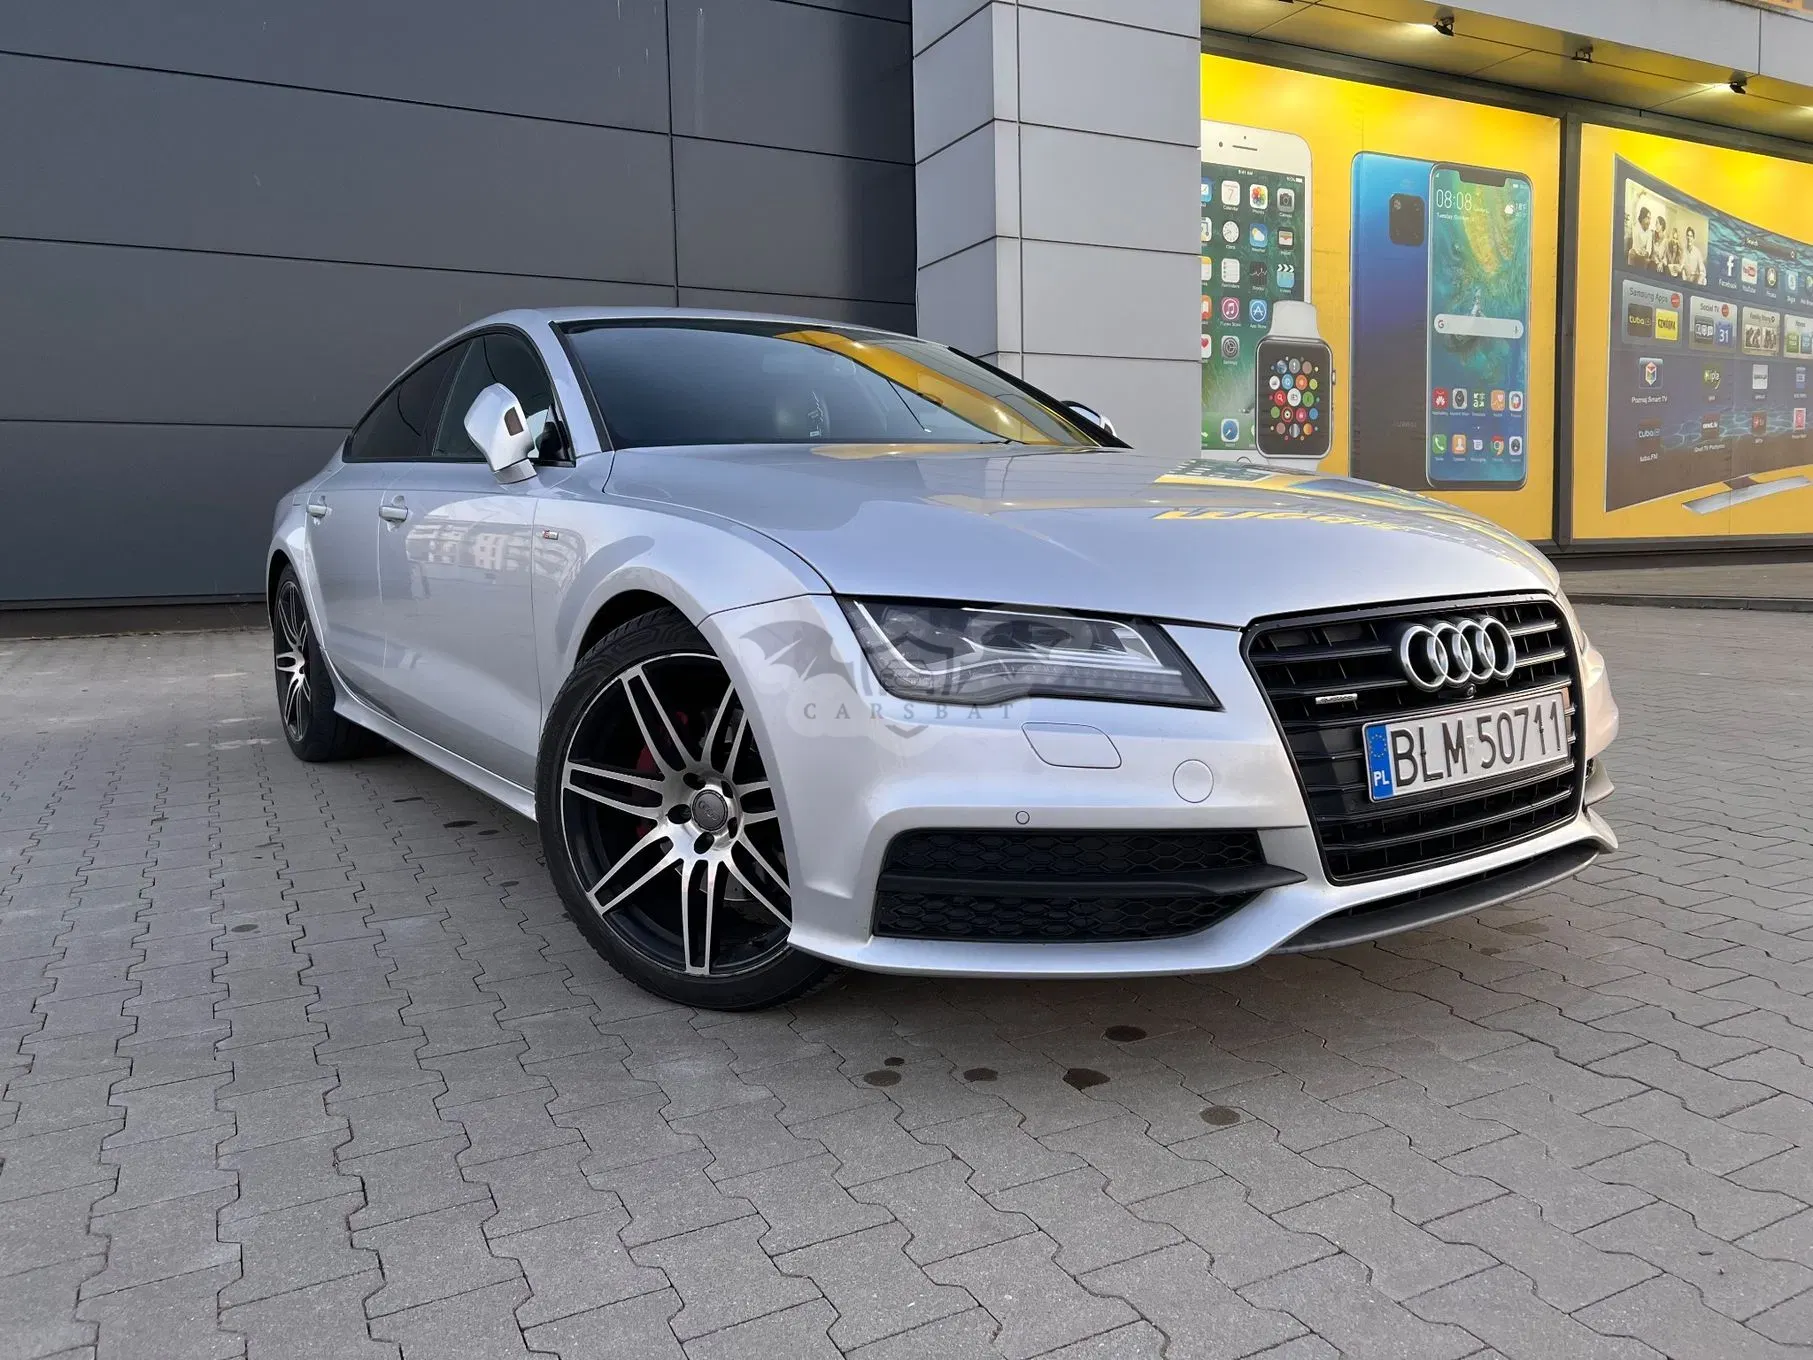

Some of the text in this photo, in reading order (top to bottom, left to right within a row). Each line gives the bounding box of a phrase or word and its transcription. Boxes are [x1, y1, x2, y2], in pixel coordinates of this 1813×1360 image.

[1436, 189, 1473, 211] 08:08
[1718, 278, 1738, 290] Facebook
[1629, 287, 1655, 303] Samsung
[1655, 291, 1669, 304] Apps
[1699, 302, 1714, 312] Social
[1719, 328, 1729, 343] 31
[1390, 701, 1561, 787] BLM 50711
[1373, 771, 1390, 787] PL
